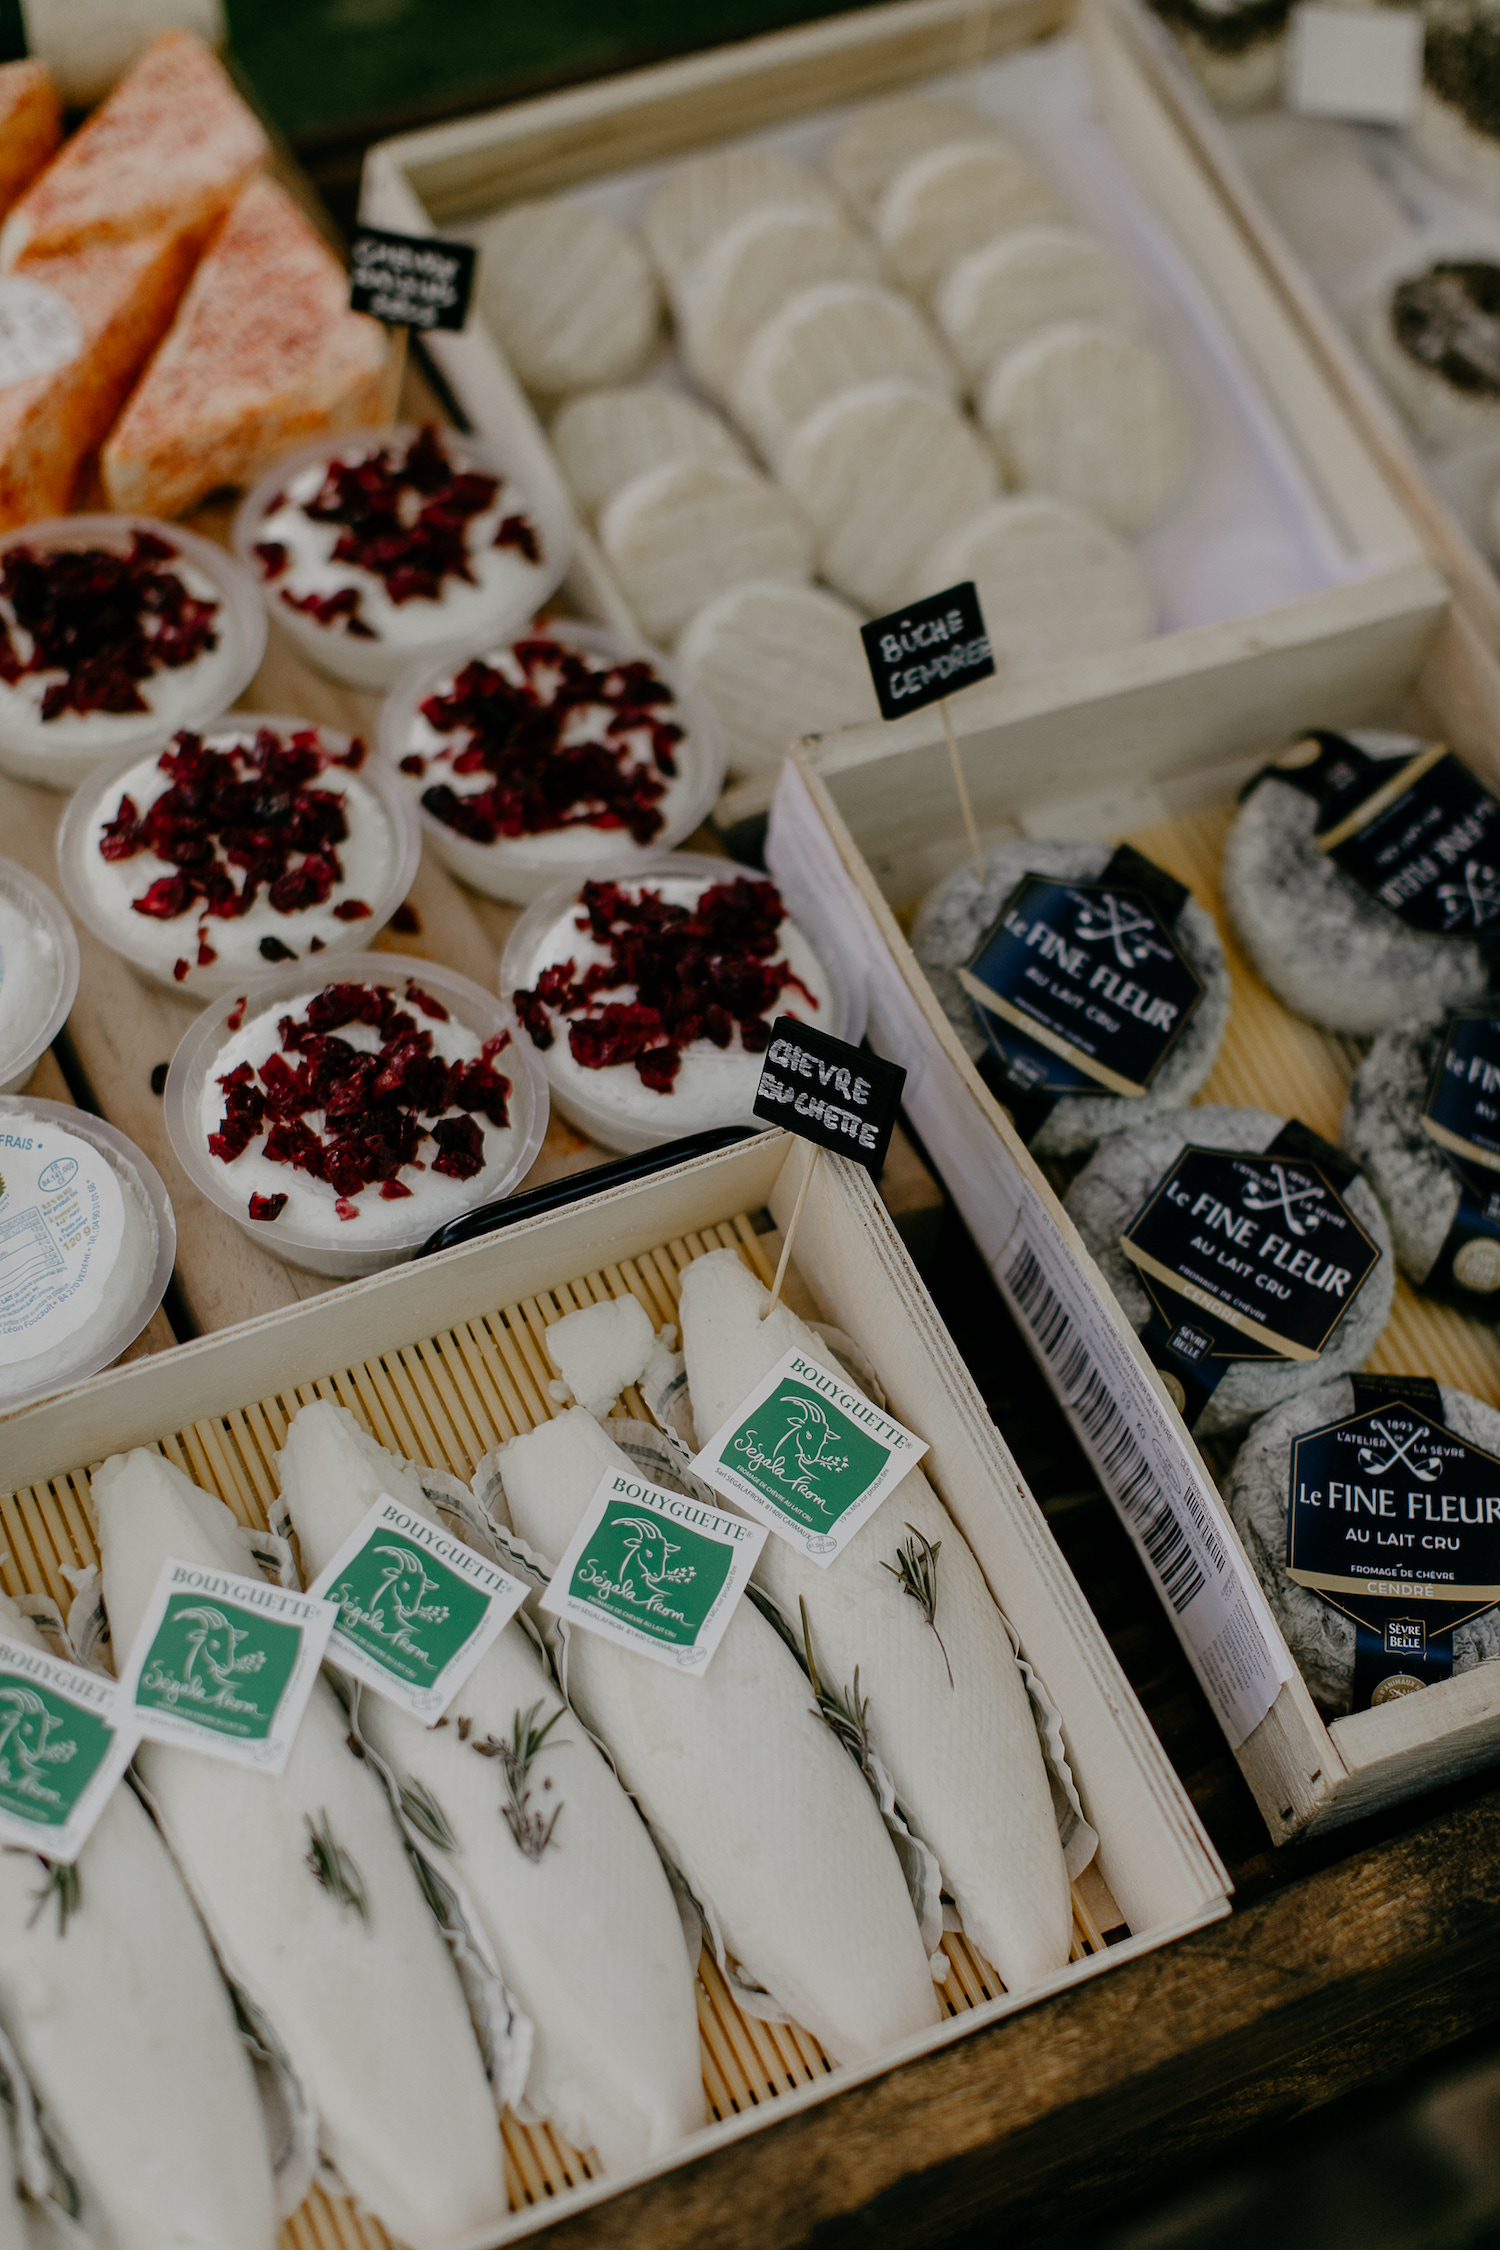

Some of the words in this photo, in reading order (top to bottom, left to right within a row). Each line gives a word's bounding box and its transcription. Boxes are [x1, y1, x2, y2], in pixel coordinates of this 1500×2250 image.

[1025, 920, 1091, 979] FINE
[1089, 965, 1178, 1033] FLEUR
[768, 1038, 872, 1105] CHEVRE
[62, 1232, 82, 1251] 120
[83, 1225, 91, 1237] g
[1166, 1181, 1191, 1207] Le
[1191, 1193, 1259, 1248] FINE
[1258, 1234, 1351, 1297] FLEUR
[1178, 1264, 1220, 1294] FROMAGE
[1190, 1236, 1215, 1256] AU
[1217, 1251, 1254, 1278] LAIT
[1255, 1274, 1292, 1300] CRU
[24, 1302, 55, 1328] Foucault
[1173, 1337, 1200, 1359] BELLE
[1387, 1420, 1413, 1432] 1893
[1337, 1432, 1387, 1448] L'ATELIER
[1413, 1443, 1427, 1454] LA
[715, 1467, 727, 1478] Sarl
[726, 1474, 765, 1506] SEGALAFROM
[764, 1503, 783, 1519] 81400
[783, 1516, 812, 1539] CARMAUX
[736, 1464, 760, 1485] FROMAGE
[759, 1480, 768, 1489] DE
[784, 1498, 791, 1508] AU
[791, 1504, 803, 1516] LAIT
[802, 1512, 813, 1522] CRU
[1300, 1483, 1322, 1506] Le
[1328, 1481, 1396, 1518] FINE
[1408, 1492, 1500, 1524] FLEUR
[1345, 1527, 1370, 1543] AU
[1377, 1531, 1416, 1547] LAIT
[1421, 1535, 1461, 1550] CRU
[1351, 1564, 1397, 1577] FROMAGE
[1400, 1568, 1413, 1577] DE
[1367, 1581, 1434, 1597] CENDRÉ
[1389, 1622, 1421, 1636] SÈVRE
[1390, 1636, 1420, 1648] BELLE
